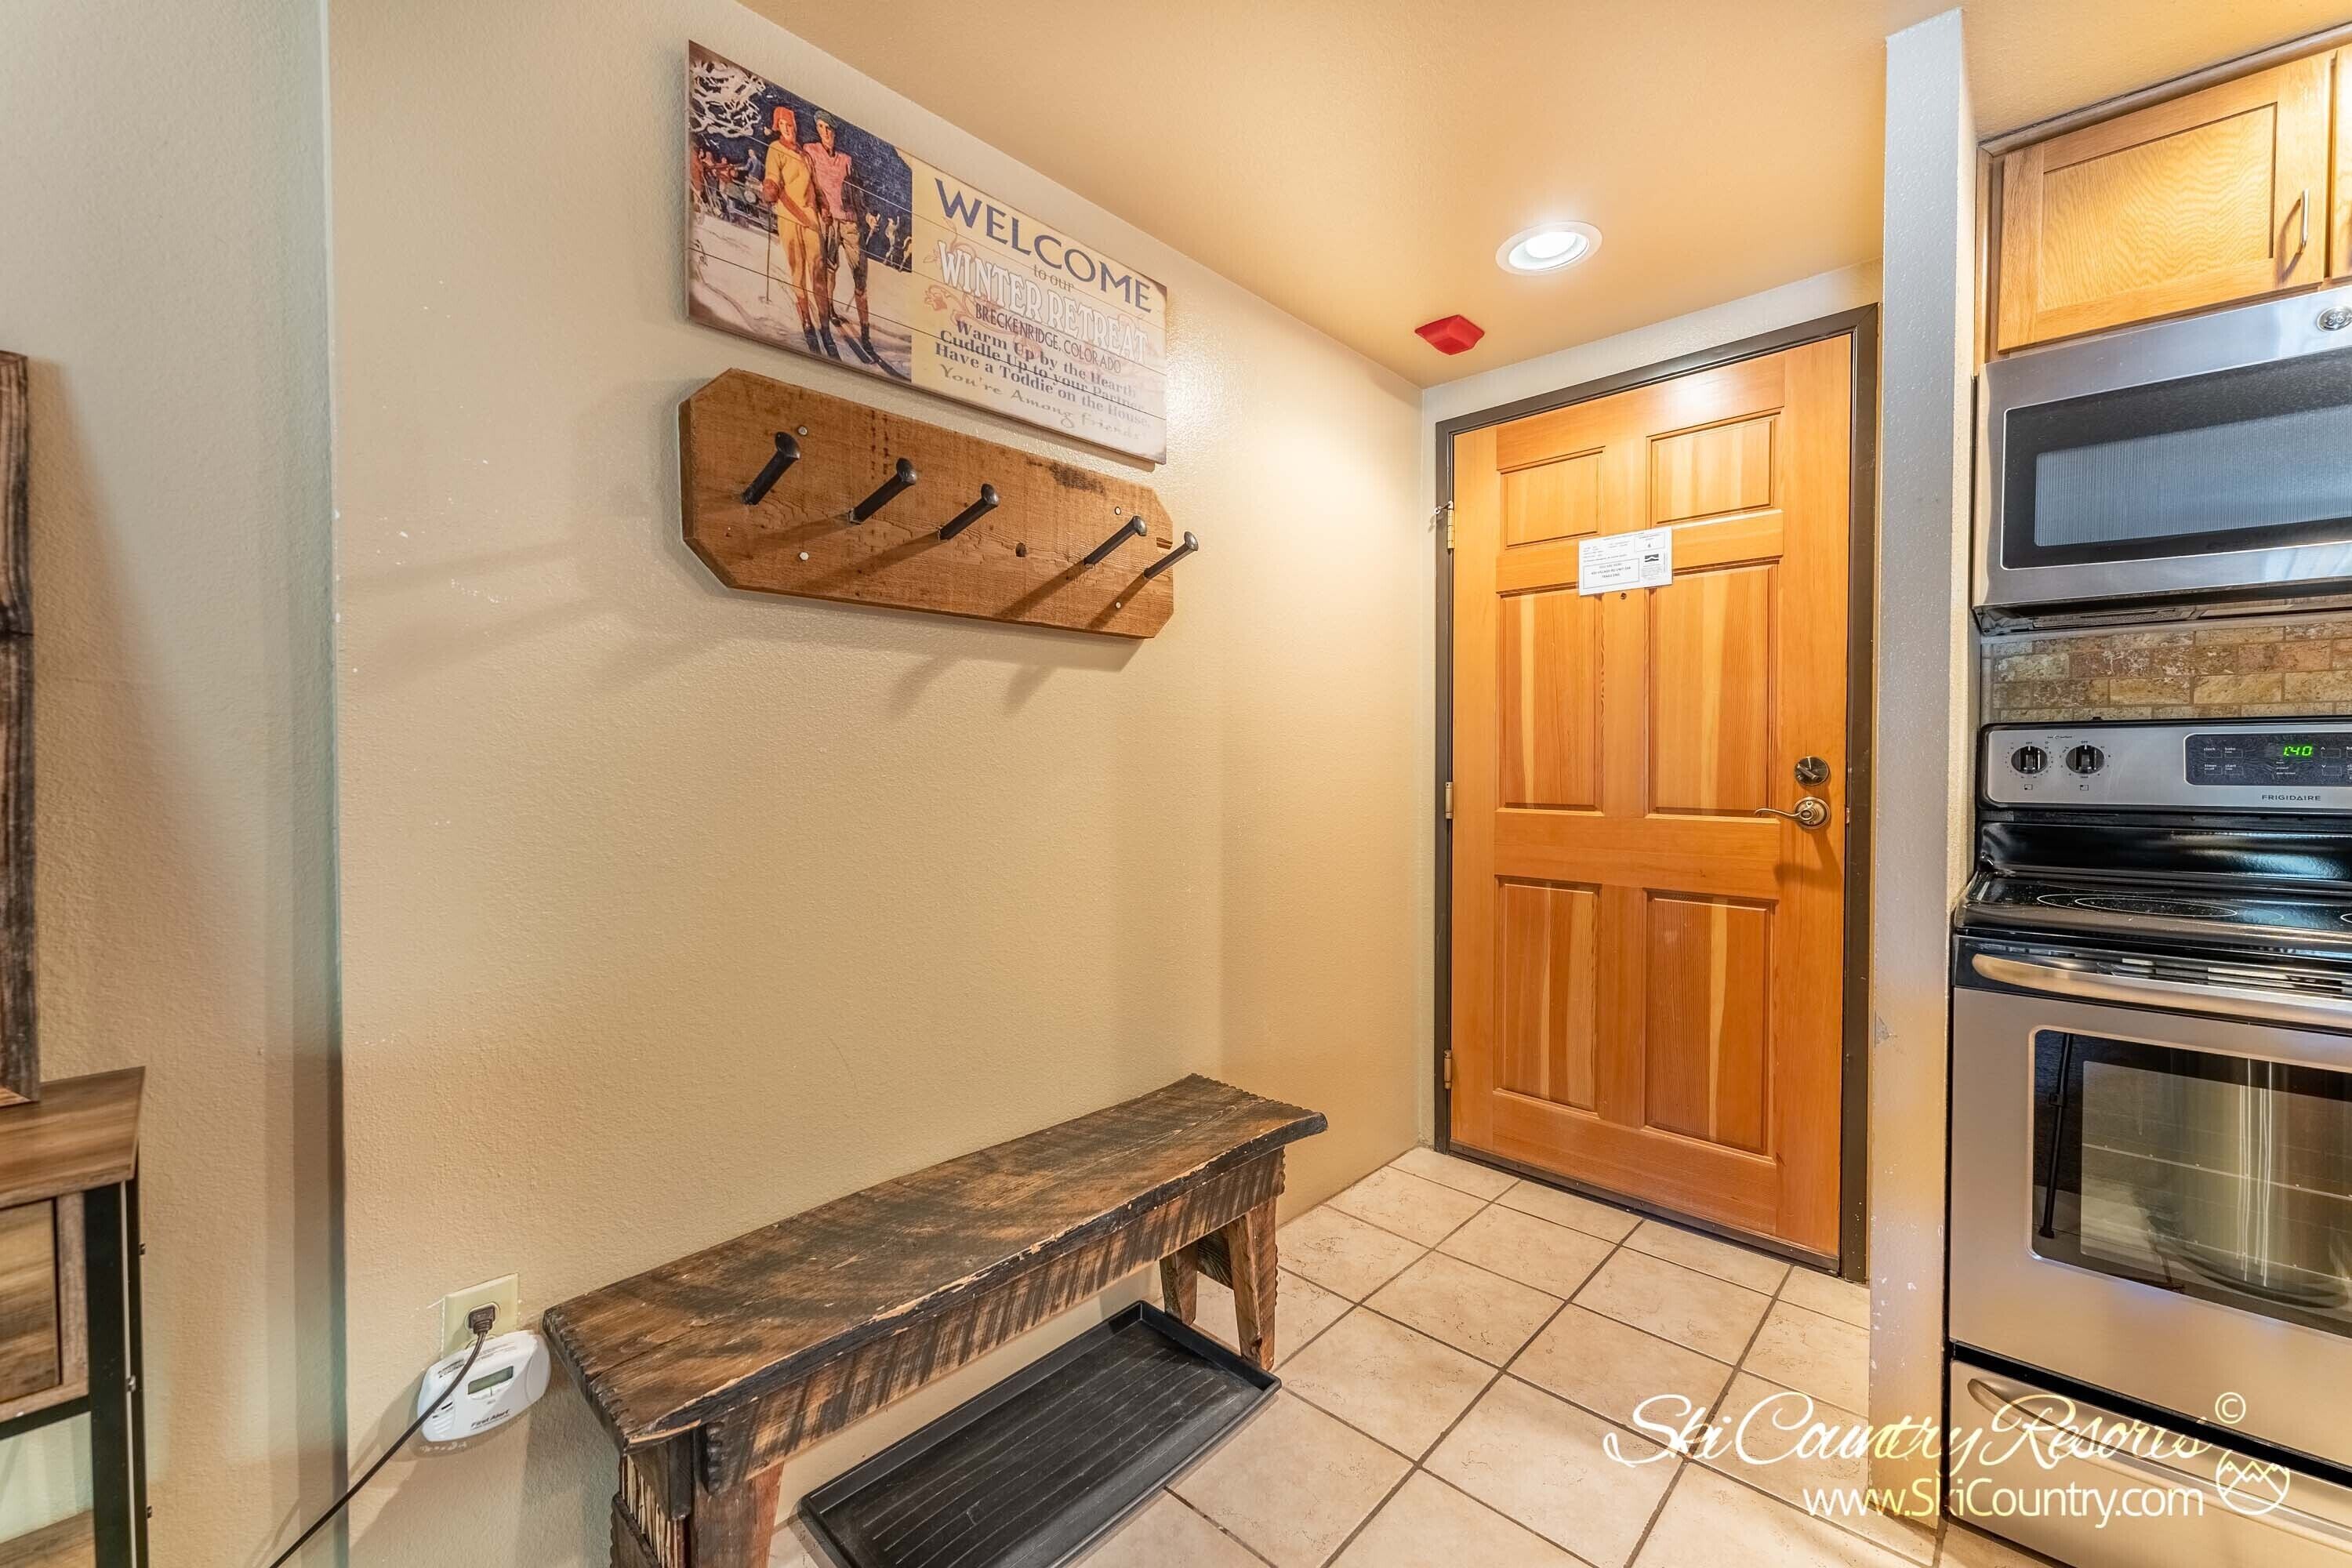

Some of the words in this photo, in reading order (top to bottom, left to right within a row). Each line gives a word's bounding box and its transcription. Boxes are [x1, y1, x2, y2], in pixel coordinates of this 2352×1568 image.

[935, 178, 1152, 313] WELCOME
[938, 240, 1043, 325] WINTER
[1047, 289, 1149, 363] RETREAT
[1033, 263, 1047, 281] to
[1050, 274, 1074, 292] our
[956, 319, 1007, 350] Warm
[1040, 350, 1058, 371] by
[1063, 361, 1087, 380] the
[975, 303, 1062, 353] BRECKENRIDGE,
[935, 341, 980, 369] Have
[985, 361, 994, 374] a
[1058, 389, 1076, 403] on
[1081, 394, 1104, 412] the
[941, 330, 1001, 361] Cuddle
[1007, 353, 1028, 374] Up
[1033, 364, 1048, 378] to
[1052, 373, 1088, 391] your
[939, 363, 1004, 395] You're
[1010, 389, 1075, 429] Among
[2282, 745, 2314, 757] 1:40
